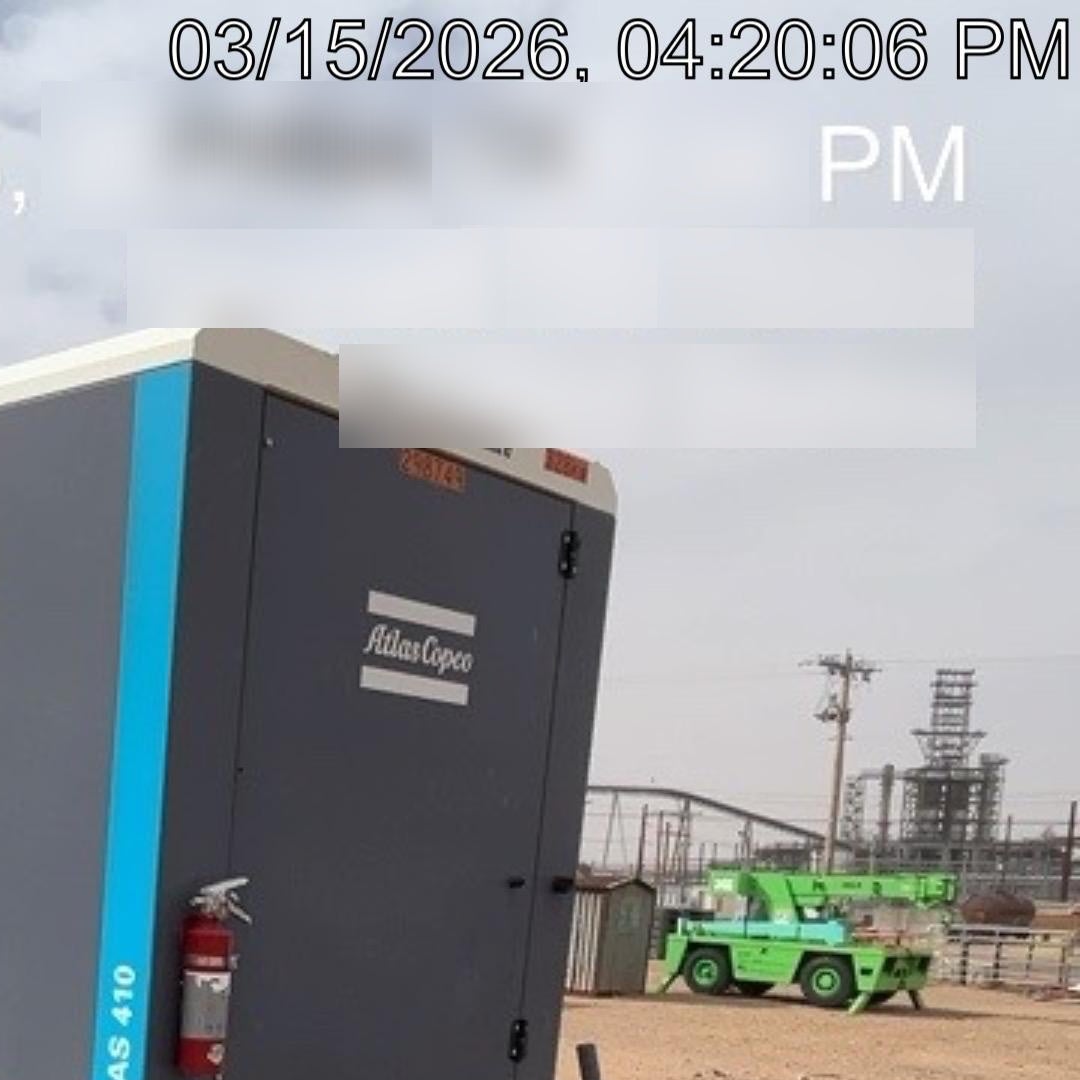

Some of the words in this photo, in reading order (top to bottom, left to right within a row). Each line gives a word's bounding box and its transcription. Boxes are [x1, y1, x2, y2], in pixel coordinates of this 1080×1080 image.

[362, 623, 421, 664] Atlas
[422, 635, 474, 675] Copco
[111, 965, 136, 1027] 410
